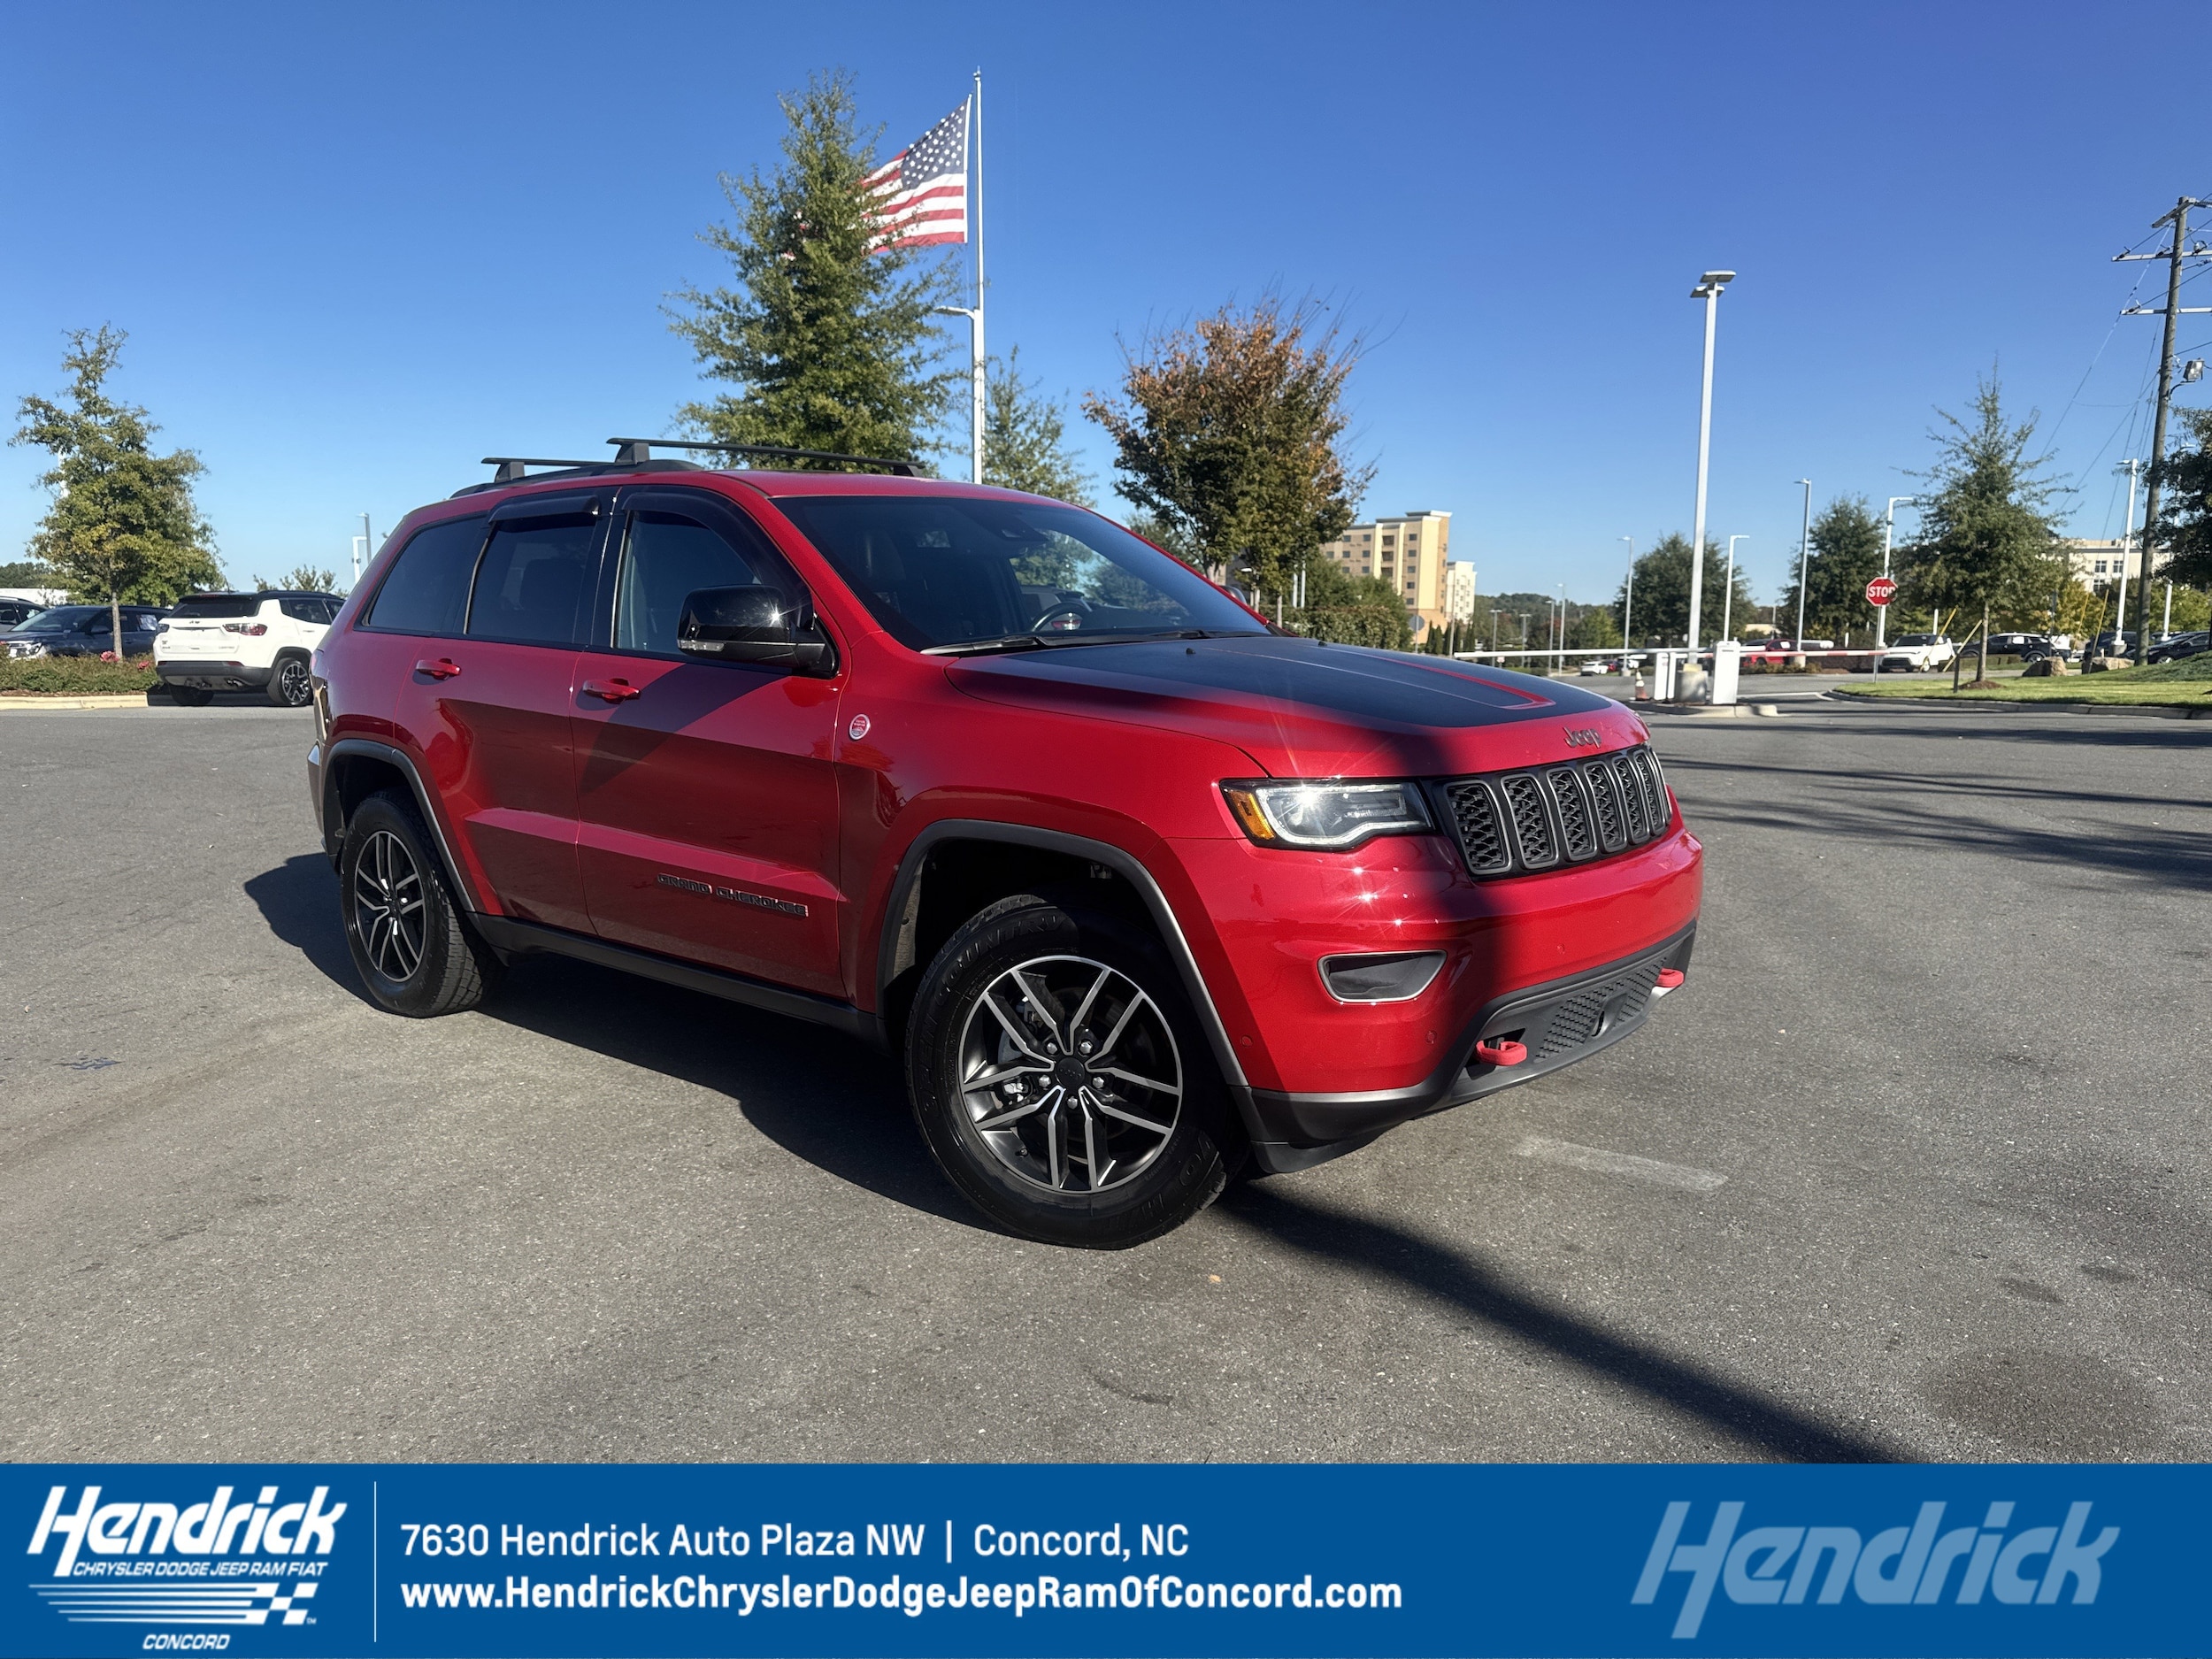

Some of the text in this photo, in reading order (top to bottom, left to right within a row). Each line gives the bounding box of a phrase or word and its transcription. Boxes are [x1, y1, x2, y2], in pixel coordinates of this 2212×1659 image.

[1563, 726, 1601, 749] Jeep
[657, 872, 809, 918] GRAND CHEROKEE
